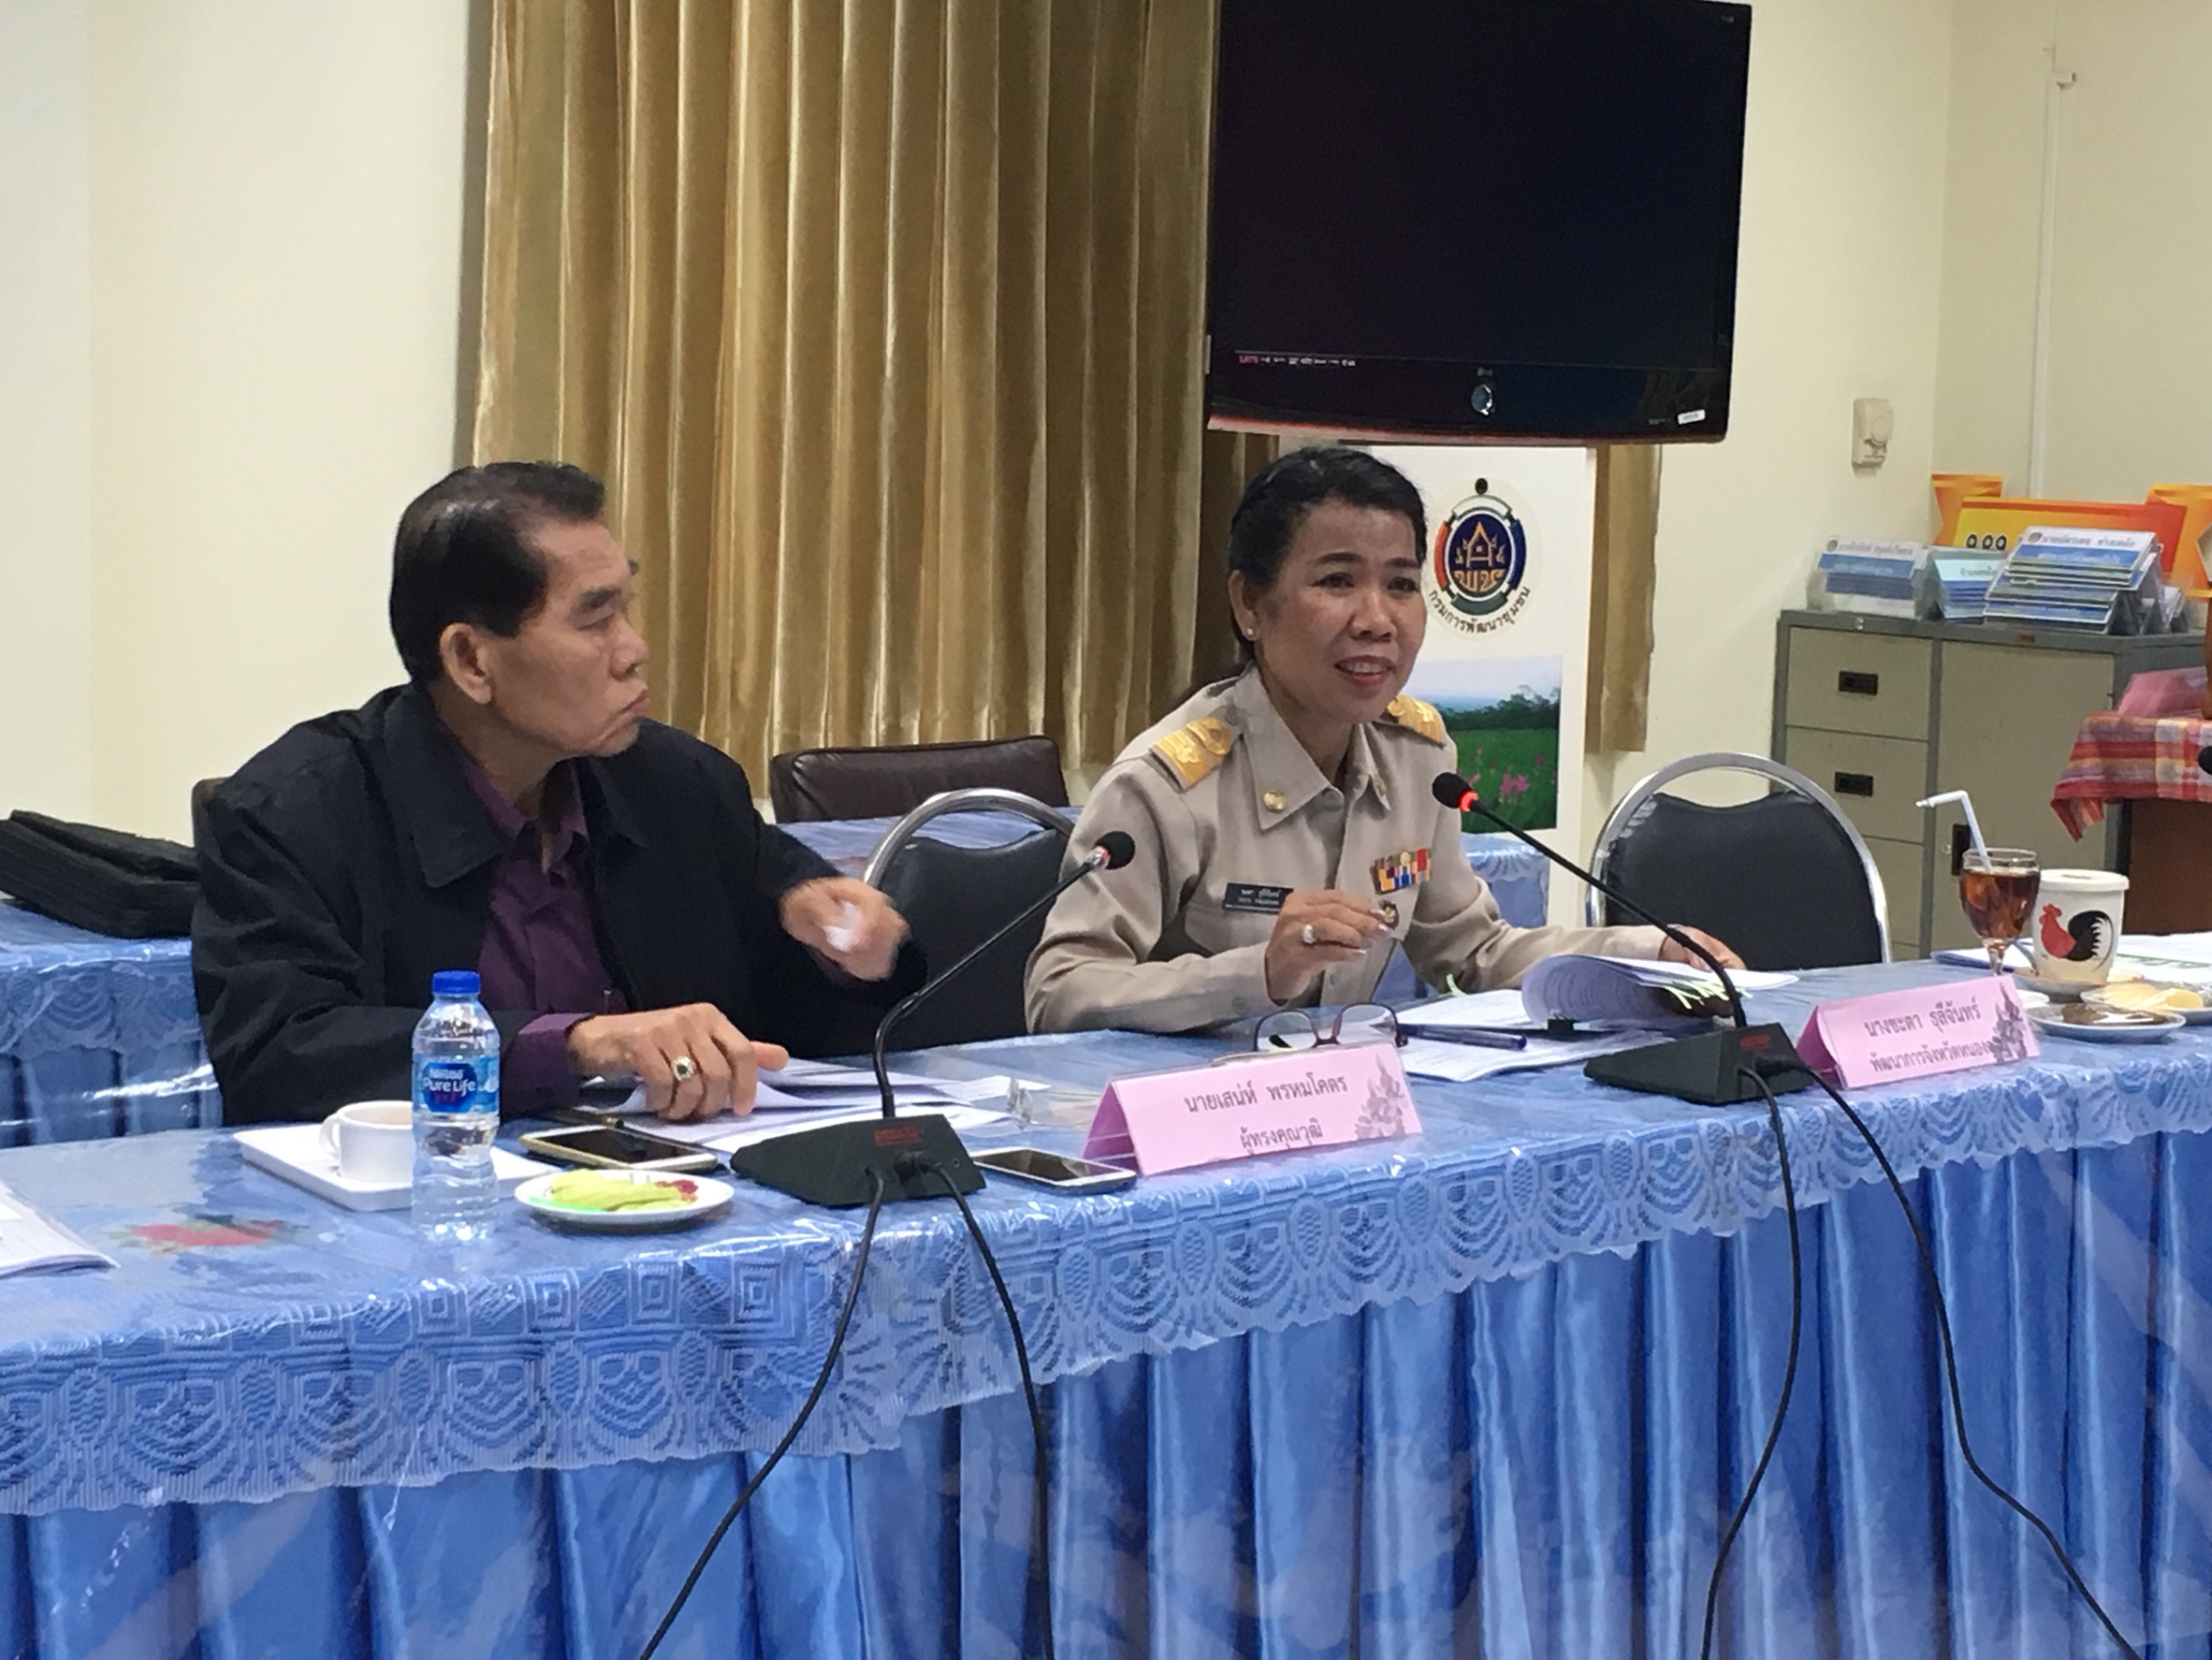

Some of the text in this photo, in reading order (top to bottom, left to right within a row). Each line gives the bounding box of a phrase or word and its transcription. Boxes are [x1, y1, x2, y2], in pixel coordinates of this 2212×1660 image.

[1428, 586, 1532, 634] กรมการพัฒนาชุมชน
[453, 1078, 476, 1098] Life
[1184, 1071, 1349, 1114] นายเสน่ห์ พรหมโคตร
[1239, 1116, 1324, 1155] ผู้ทรงคุณวุฒิ
